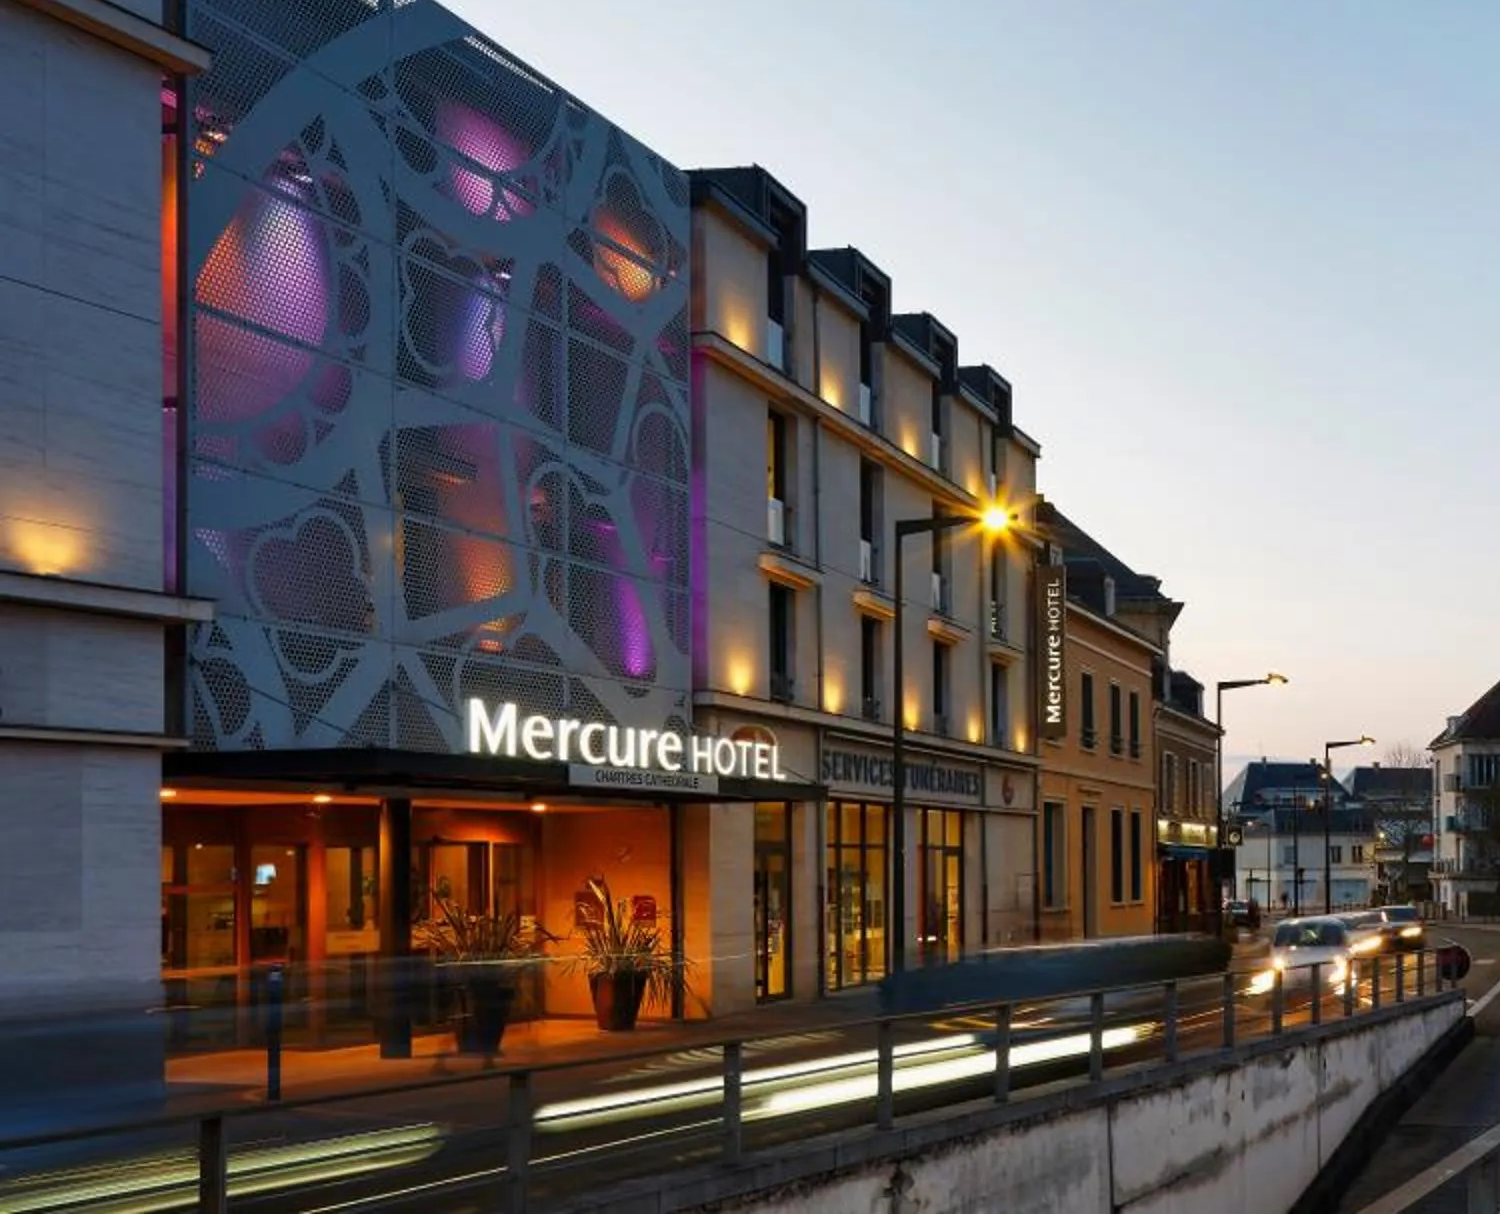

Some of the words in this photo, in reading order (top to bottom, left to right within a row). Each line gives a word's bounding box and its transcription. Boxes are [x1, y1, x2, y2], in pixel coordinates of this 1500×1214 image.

[1047, 578, 1061, 632] HOTEL
[1046, 635, 1062, 724] Mercure
[467, 697, 682, 771] Mercure
[692, 735, 787, 780] HOTEL
